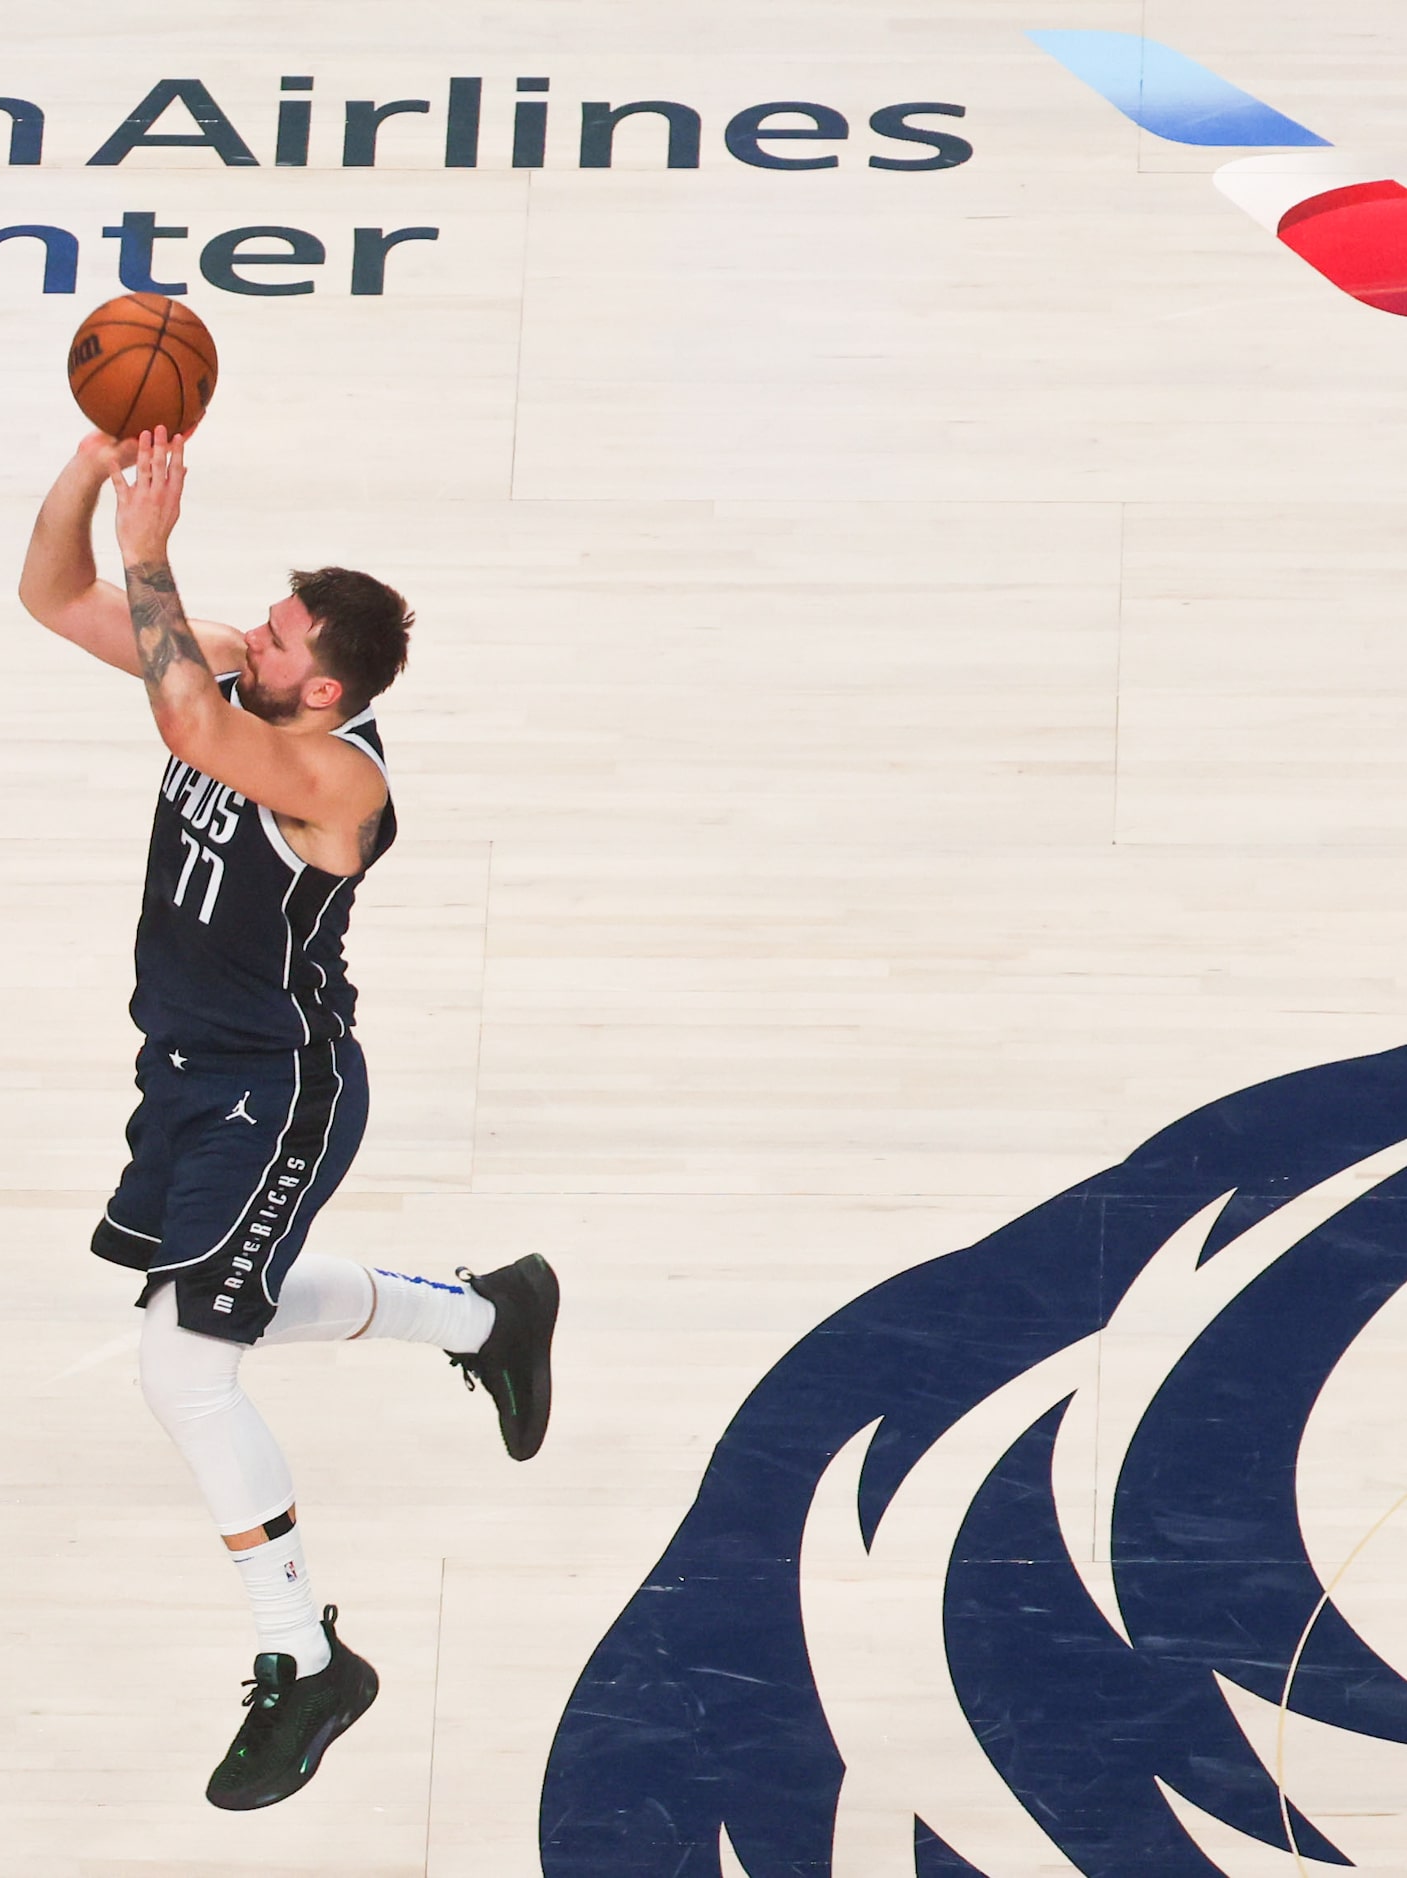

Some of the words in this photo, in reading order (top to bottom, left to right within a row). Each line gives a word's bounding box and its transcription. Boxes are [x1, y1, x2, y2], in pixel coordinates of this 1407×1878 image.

[86, 77, 972, 171] Airlines
[173, 828, 225, 924] 77
[213, 1157, 306, 1314] MAVERICKS
